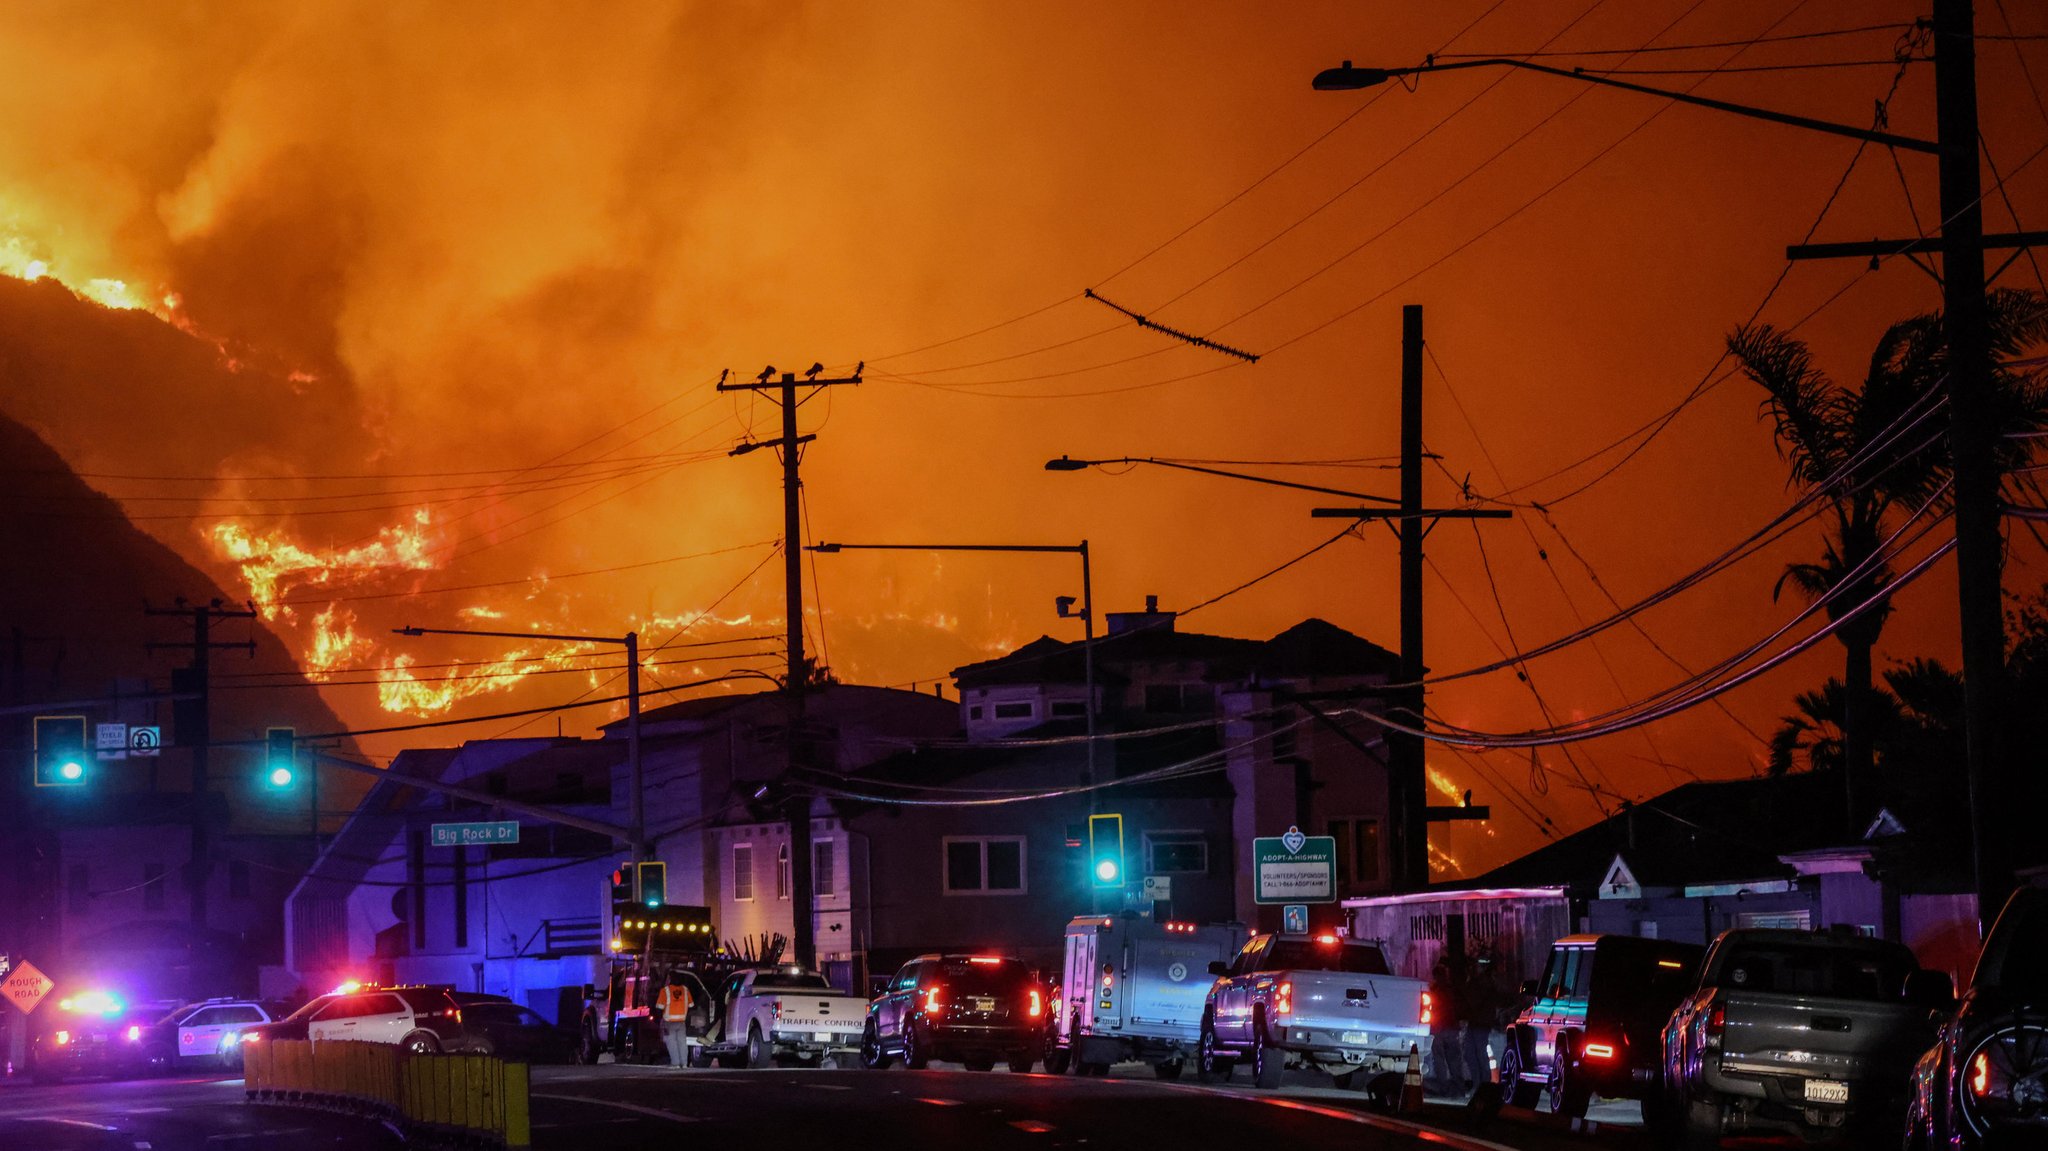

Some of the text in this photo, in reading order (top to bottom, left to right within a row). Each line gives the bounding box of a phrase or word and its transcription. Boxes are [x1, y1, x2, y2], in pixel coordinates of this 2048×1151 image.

[438, 827, 512, 844] Big Rock Dr
[10, 977, 42, 987] ROUGH
[14, 989, 40, 999] ROAD
[782, 1018, 819, 1026] TRAFFIC
